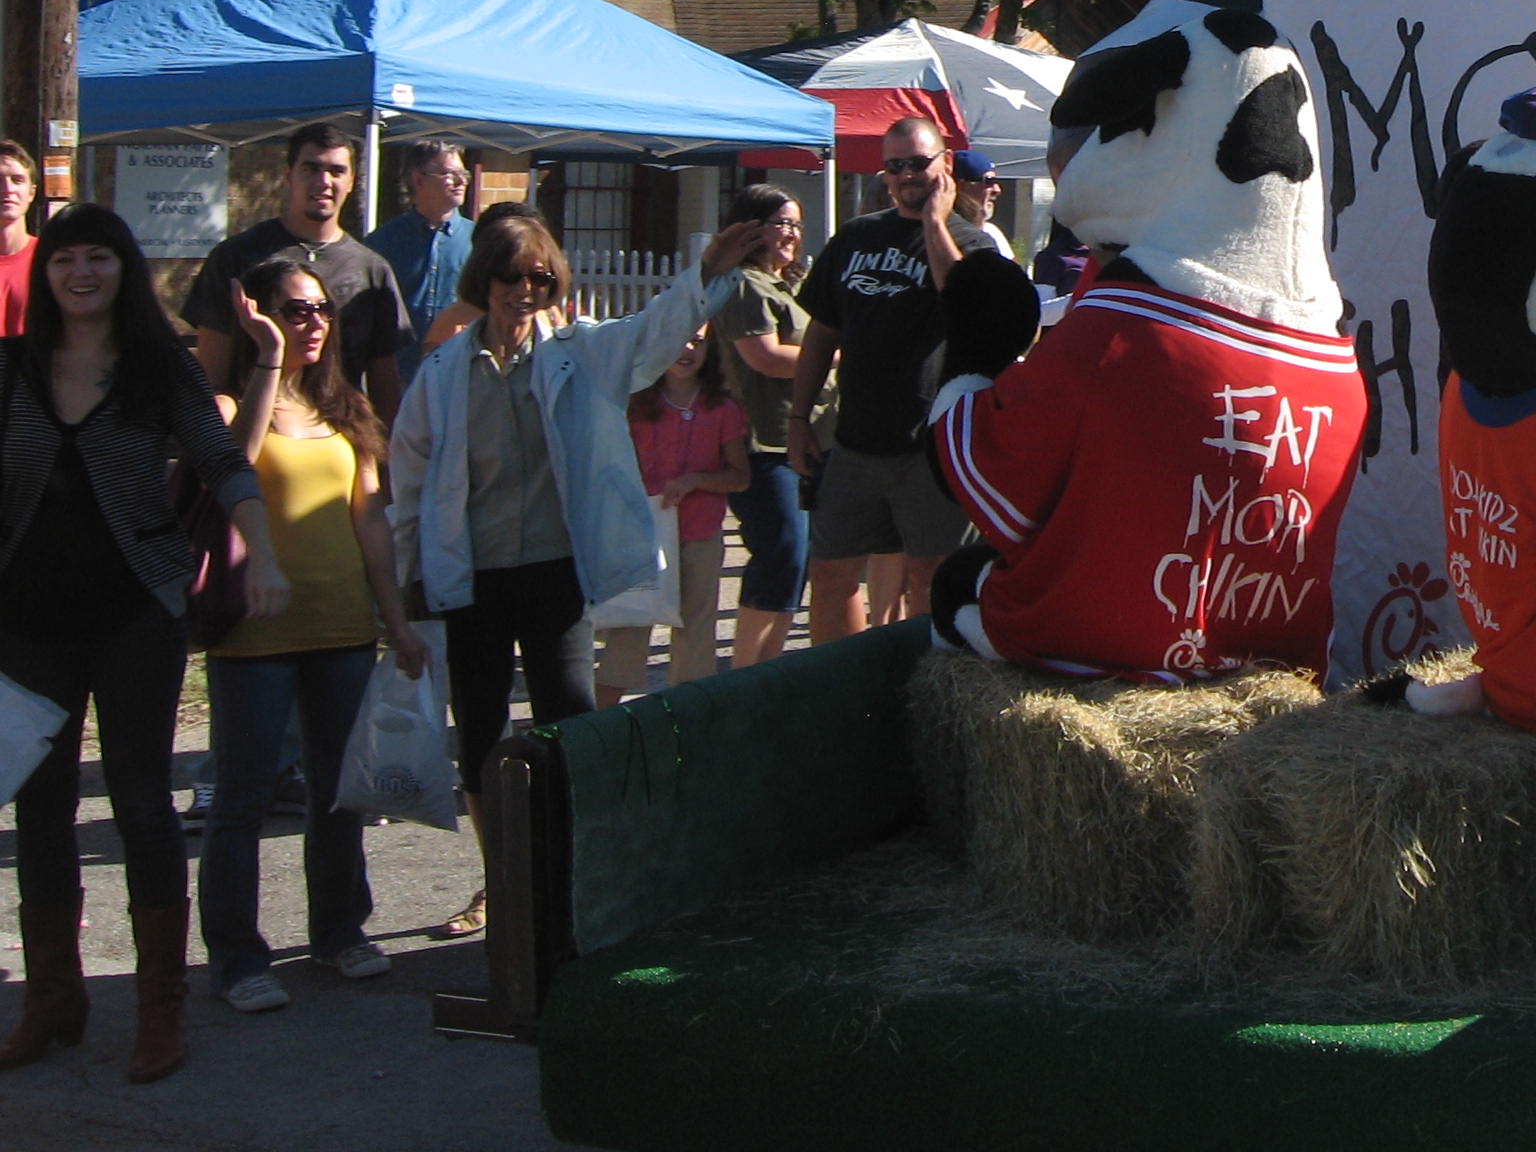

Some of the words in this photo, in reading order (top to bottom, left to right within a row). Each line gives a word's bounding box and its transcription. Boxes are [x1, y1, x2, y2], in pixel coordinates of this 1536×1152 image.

[143, 154, 215, 168] ASSOCIATES
[841, 251, 882, 282] JIM
[1202, 384, 1333, 489] EAT
[1183, 474, 1312, 575] MOR
[1154, 552, 1318, 626] CHIKIN
